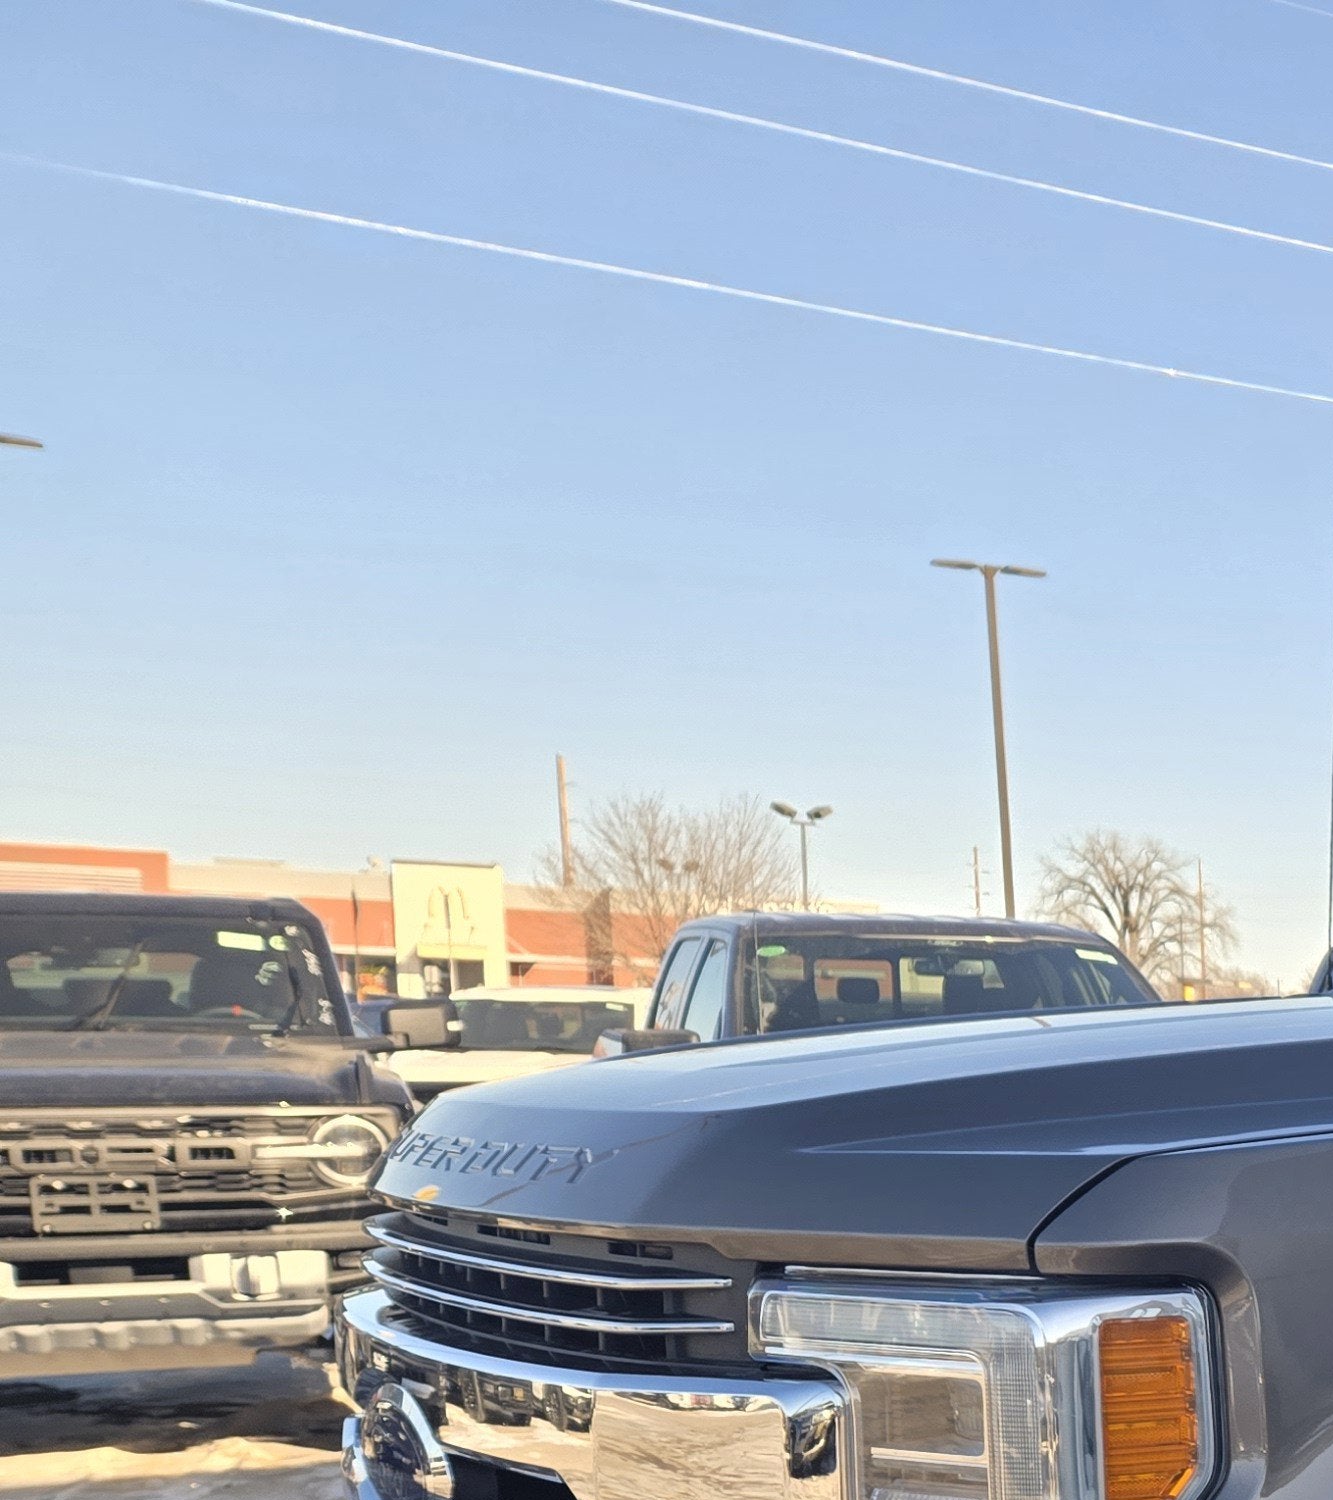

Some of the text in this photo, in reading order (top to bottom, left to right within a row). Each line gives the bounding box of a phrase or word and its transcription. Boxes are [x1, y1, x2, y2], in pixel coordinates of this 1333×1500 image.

[0, 1137, 250, 1174] ORD
[390, 1128, 594, 1184] UPER DUTY
